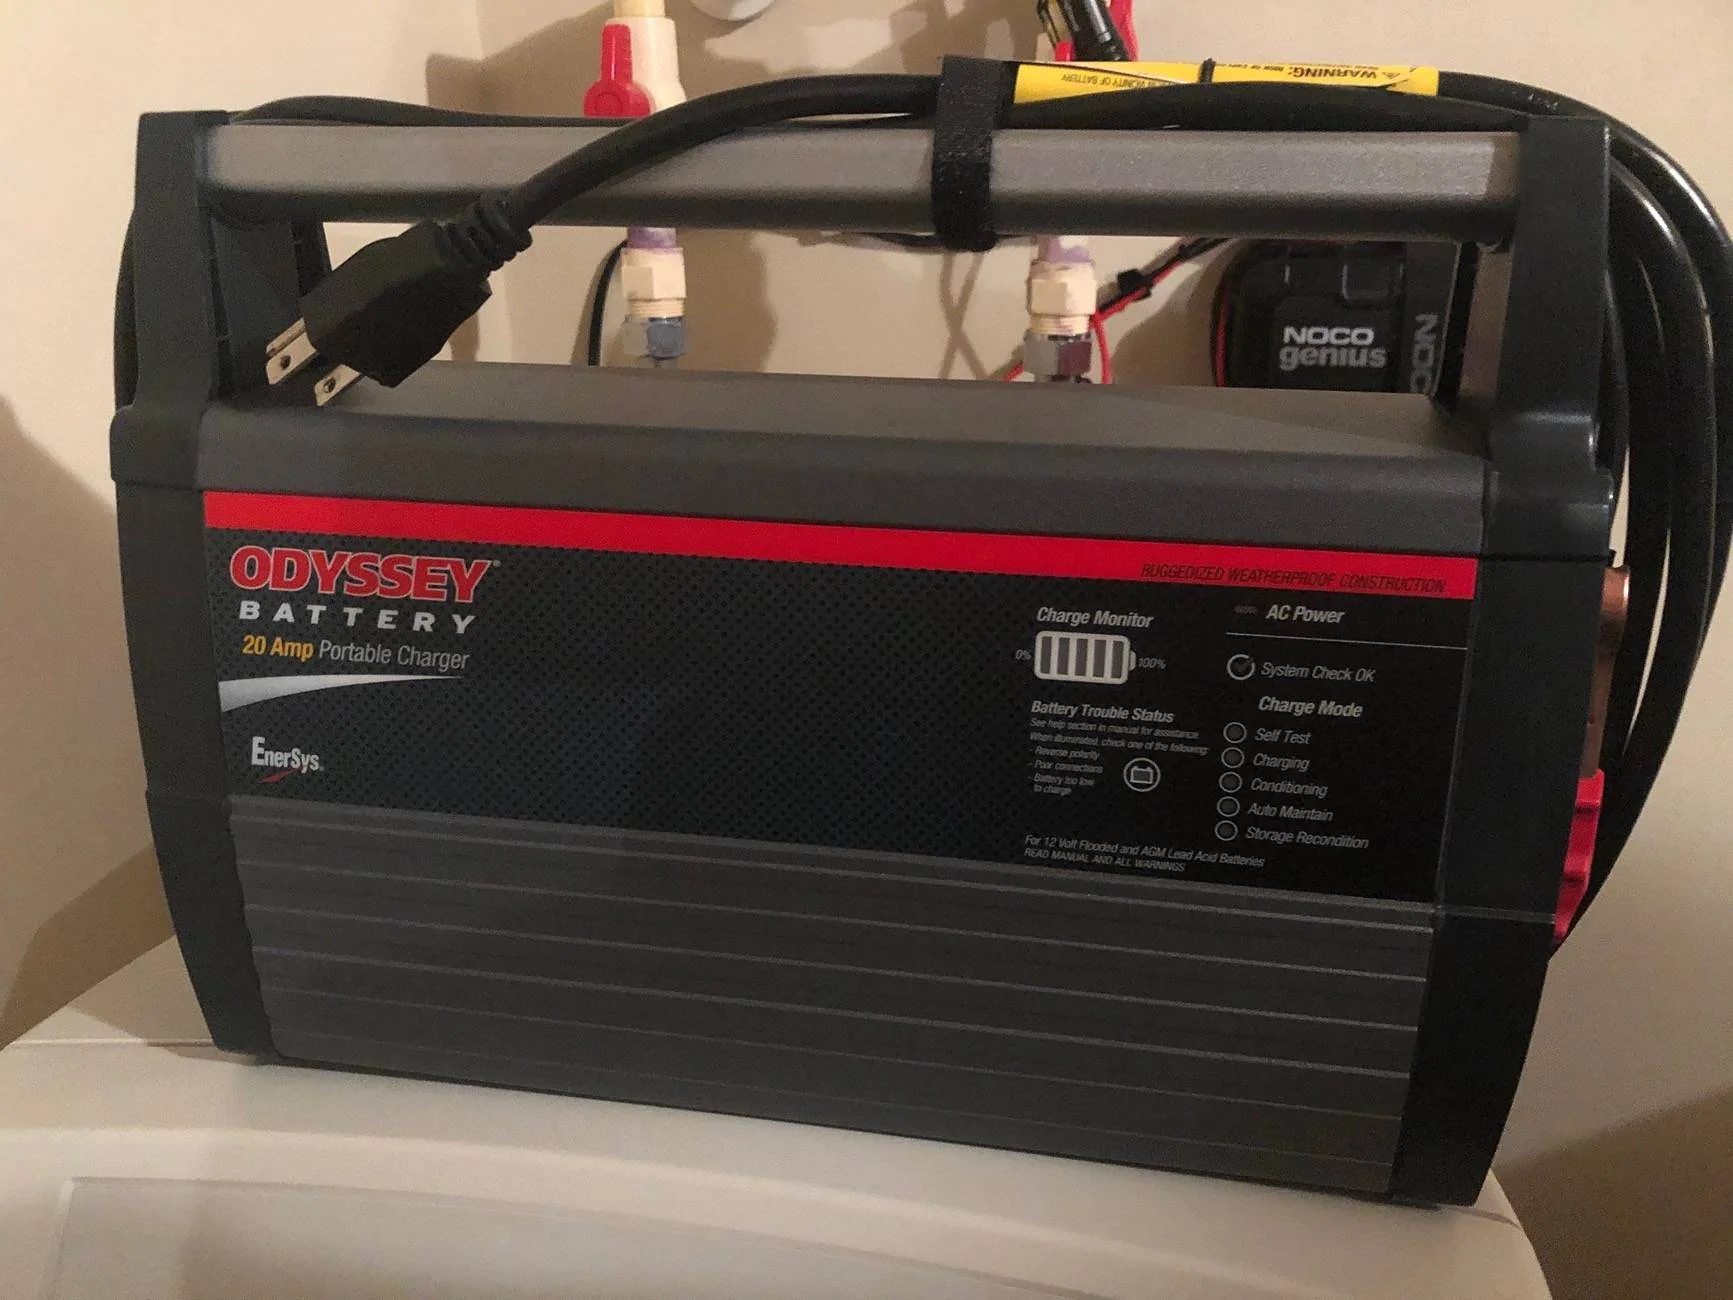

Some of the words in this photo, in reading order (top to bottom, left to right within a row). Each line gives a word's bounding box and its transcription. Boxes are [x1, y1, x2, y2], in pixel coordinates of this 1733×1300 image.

[1062, 73, 1098, 86] BATTERY
[1288, 66, 1377, 79] WARNING:
[1283, 326, 1375, 346] NOCO
[1279, 346, 1387, 371] genius
[1409, 313, 1439, 394] NOC
[1141, 563, 1224, 580] RUGGEDIZED
[1228, 567, 1336, 587] WEATHERPROOF
[1339, 573, 1446, 593] CONSTRUCTION
[239, 601, 476, 634] BATTERY
[1037, 606, 1090, 627] Charge
[1093, 610, 1154, 628] Monitor
[1266, 604, 1291, 620] AC
[1293, 606, 1345, 624] Power
[242, 634, 266, 655] 20
[270, 636, 314, 663] Amp
[319, 639, 392, 664] Portable
[397, 645, 470, 672] Charger
[1015, 649, 1032, 660] 0%
[1138, 657, 1166, 669] 100%
[1261, 662, 1309, 678] System
[1312, 665, 1353, 681] Check
[1355, 668, 1376, 682] OK
[1031, 700, 1078, 717] Battery
[1081, 703, 1129, 720] Trouble
[1131, 707, 1175, 723] Status
[1258, 696, 1315, 716] Charge
[1318, 700, 1363, 718] Mode
[1108, 724, 1139, 735] manual
[1254, 727, 1281, 742] Self
[1283, 730, 1312, 745] Test
[1035, 746, 1068, 758] Reverse
[1101, 738, 1125, 748] check
[1034, 759, 1053, 770] Poor
[1054, 762, 1104, 774] connections
[1253, 752, 1310, 772] Charging
[1034, 773, 1063, 785] Battery
[1251, 777, 1328, 799] Conditioning
[1248, 802, 1276, 817] Auto
[1279, 805, 1334, 822] Maintain
[1246, 826, 1294, 844] Storage
[1296, 831, 1369, 849] Recondition
[1023, 847, 1049, 859] READ
[1051, 851, 1090, 863] MANUAL
[1092, 854, 1114, 865] AND
[1115, 857, 1133, 867] ALL
[1135, 859, 1186, 872] WARNINGS
[1024, 834, 1042, 846] For
[1044, 837, 1057, 847] 12
[1059, 838, 1077, 849] Volt
[1079, 840, 1118, 854] Flooded
[1119, 843, 1139, 855] and
[1141, 846, 1167, 858] AGM
[1167, 848, 1194, 861] Lead
[1195, 850, 1218, 863] Acid
[1219, 852, 1265, 867] Batteries
